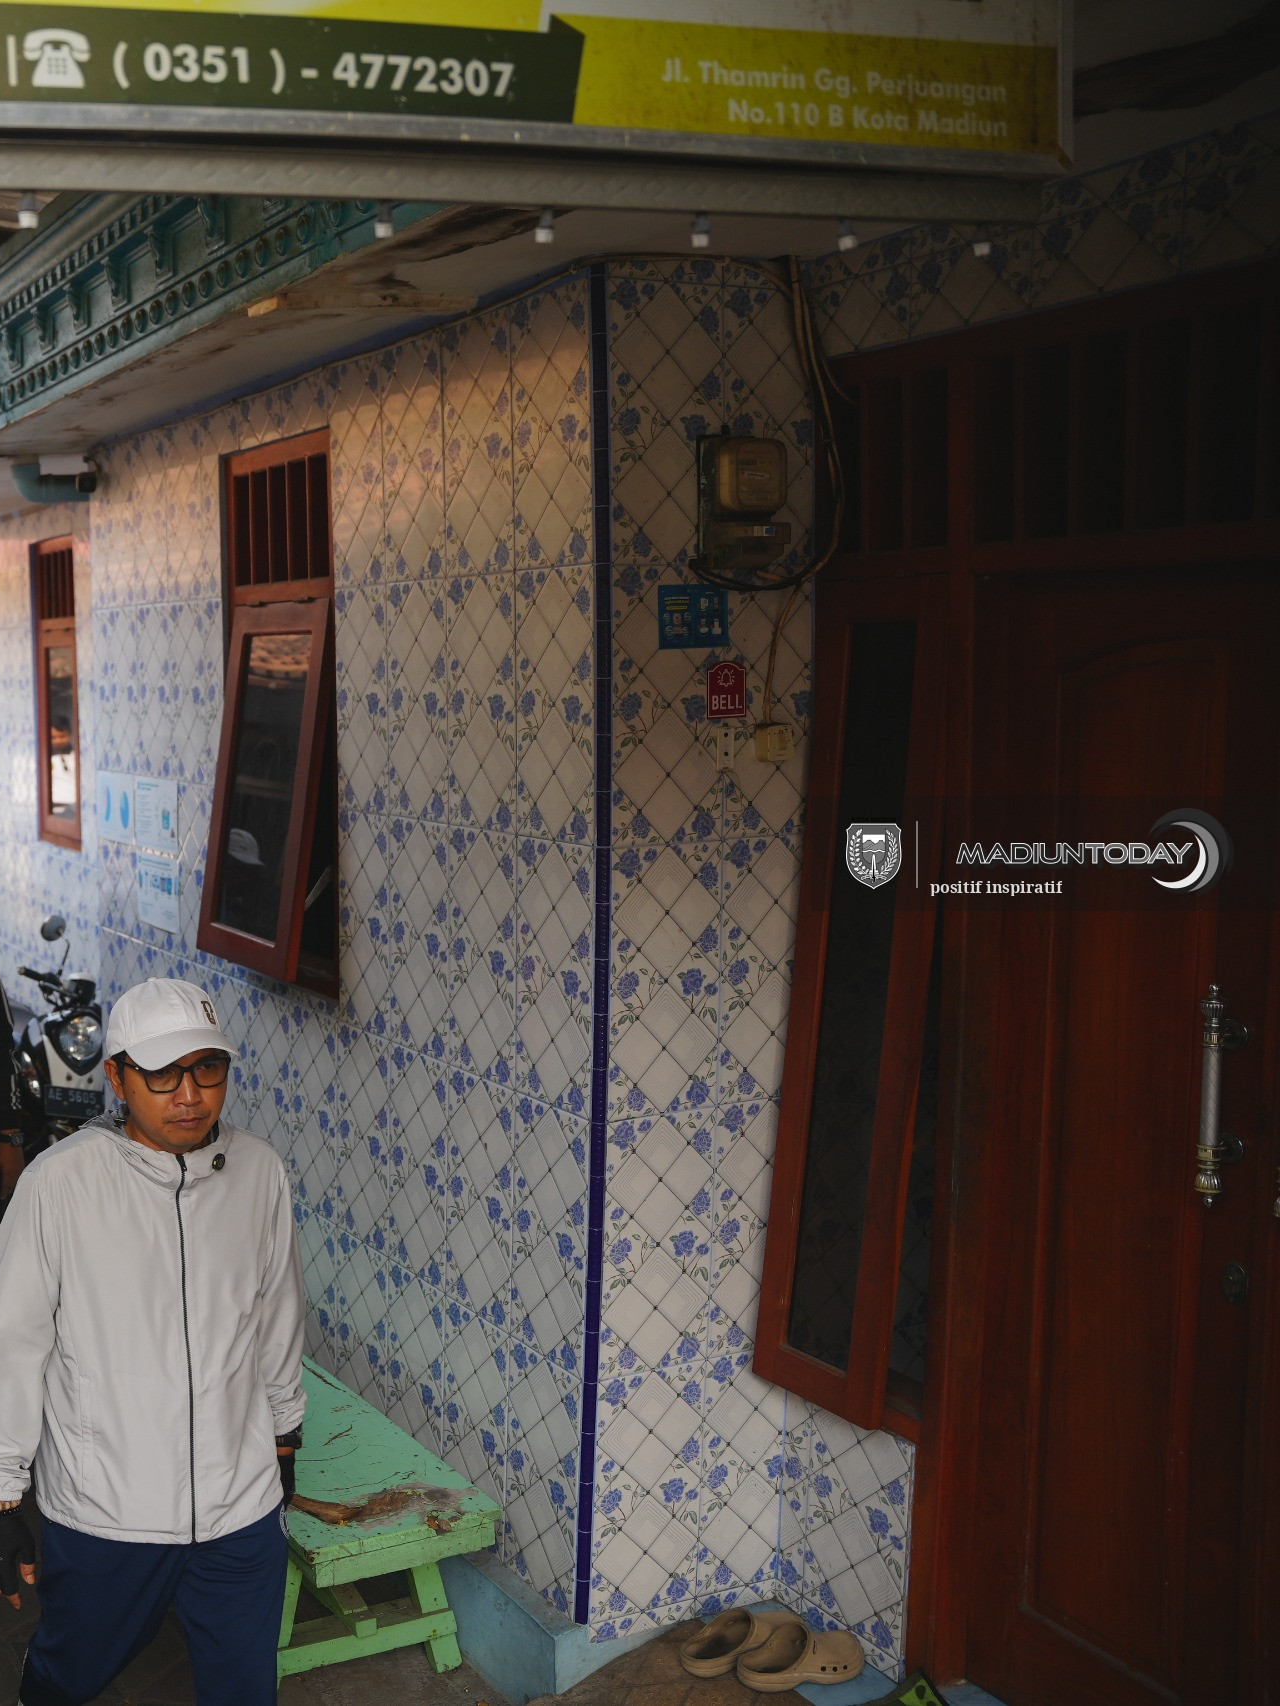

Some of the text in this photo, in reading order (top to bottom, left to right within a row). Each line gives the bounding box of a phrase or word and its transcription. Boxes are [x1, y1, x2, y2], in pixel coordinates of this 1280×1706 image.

[332, 52, 516, 98] 4772307
[661, 58, 1008, 106] Jl. Thamrin Gg. Perjuangan
[727, 98, 1008, 139] No.110 B Kota Madiun
[711, 694, 742, 710] BELL
[48, 1087, 63, 1100] AE
